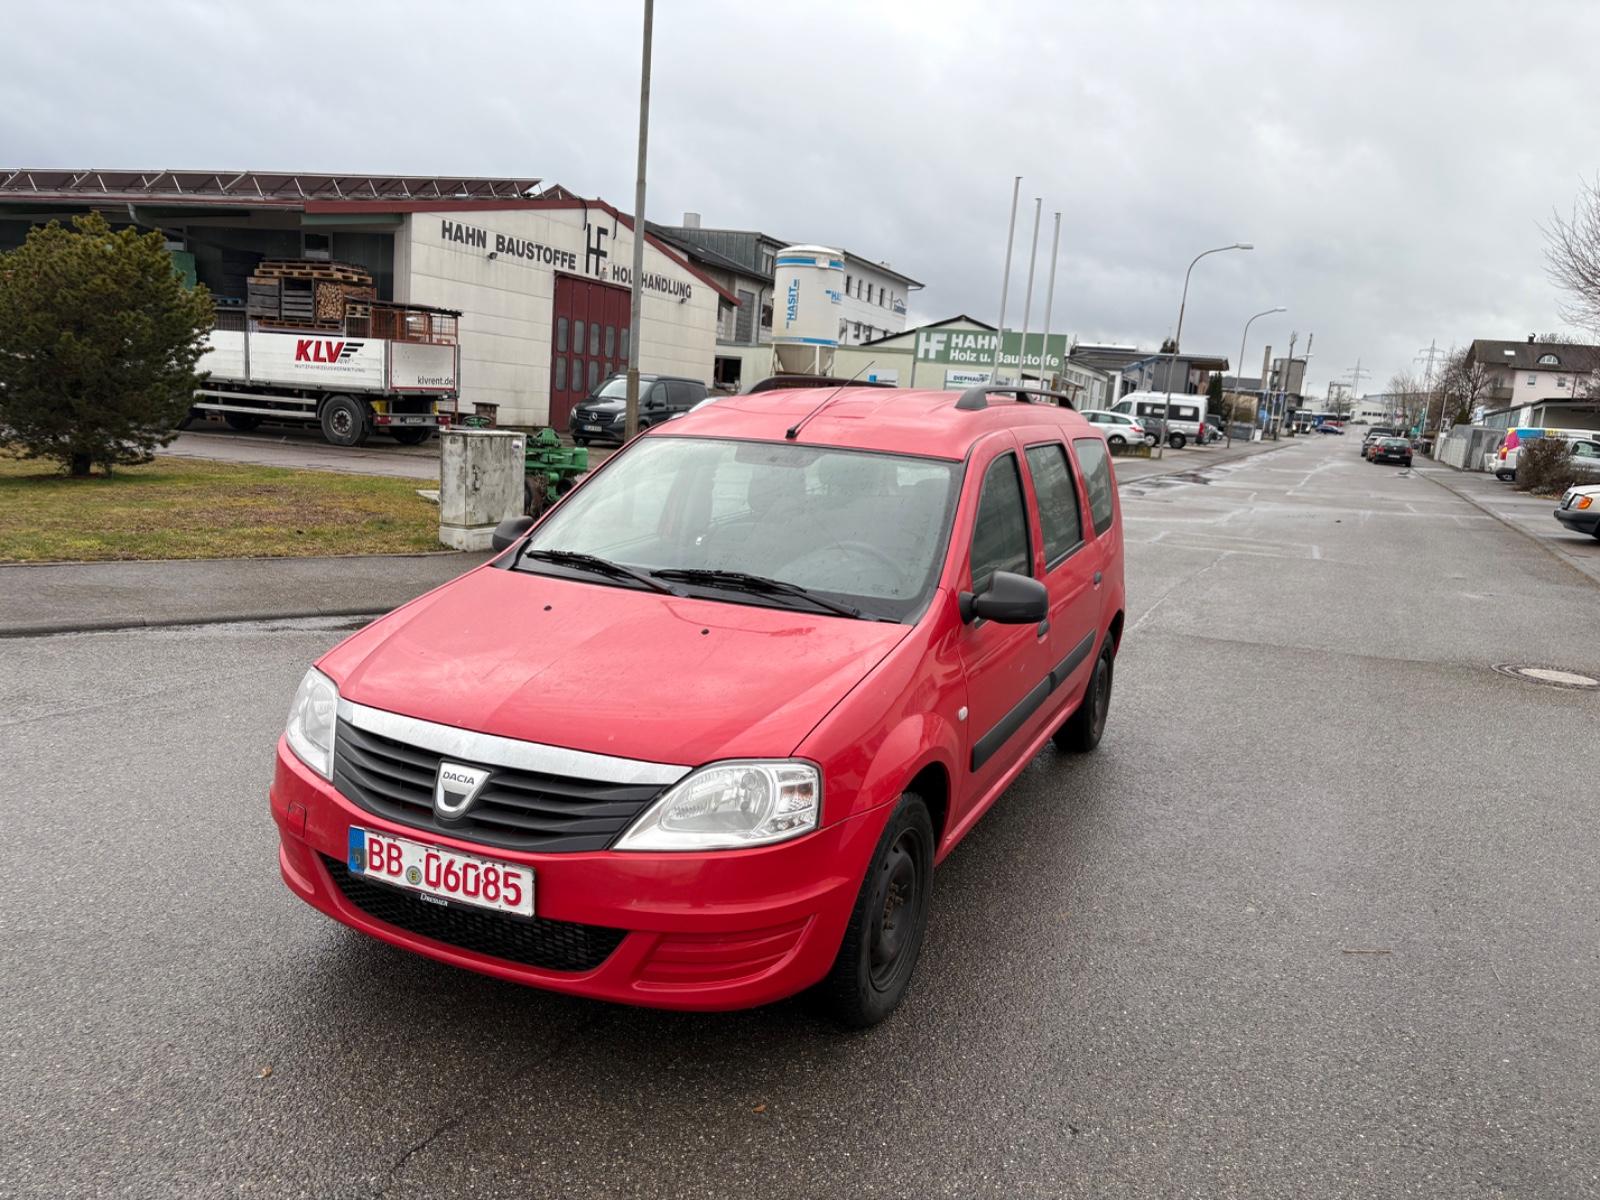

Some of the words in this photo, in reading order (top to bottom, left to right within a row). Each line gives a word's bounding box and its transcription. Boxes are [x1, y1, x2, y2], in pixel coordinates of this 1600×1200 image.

[442, 220, 487, 248] HAHN
[496, 234, 577, 270] BAUSTOFFE
[612, 264, 692, 298] HOLHANDLUNG
[787, 286, 796, 320] HASIT
[295, 339, 345, 363] KLV
[951, 333, 1003, 350] HAHN
[950, 350, 976, 362] Holz
[979, 353, 991, 362] u.
[417, 376, 454, 385] klvrent.de
[443, 771, 475, 785] DACIA
[368, 837, 403, 876] BB
[424, 852, 522, 906] 06085
